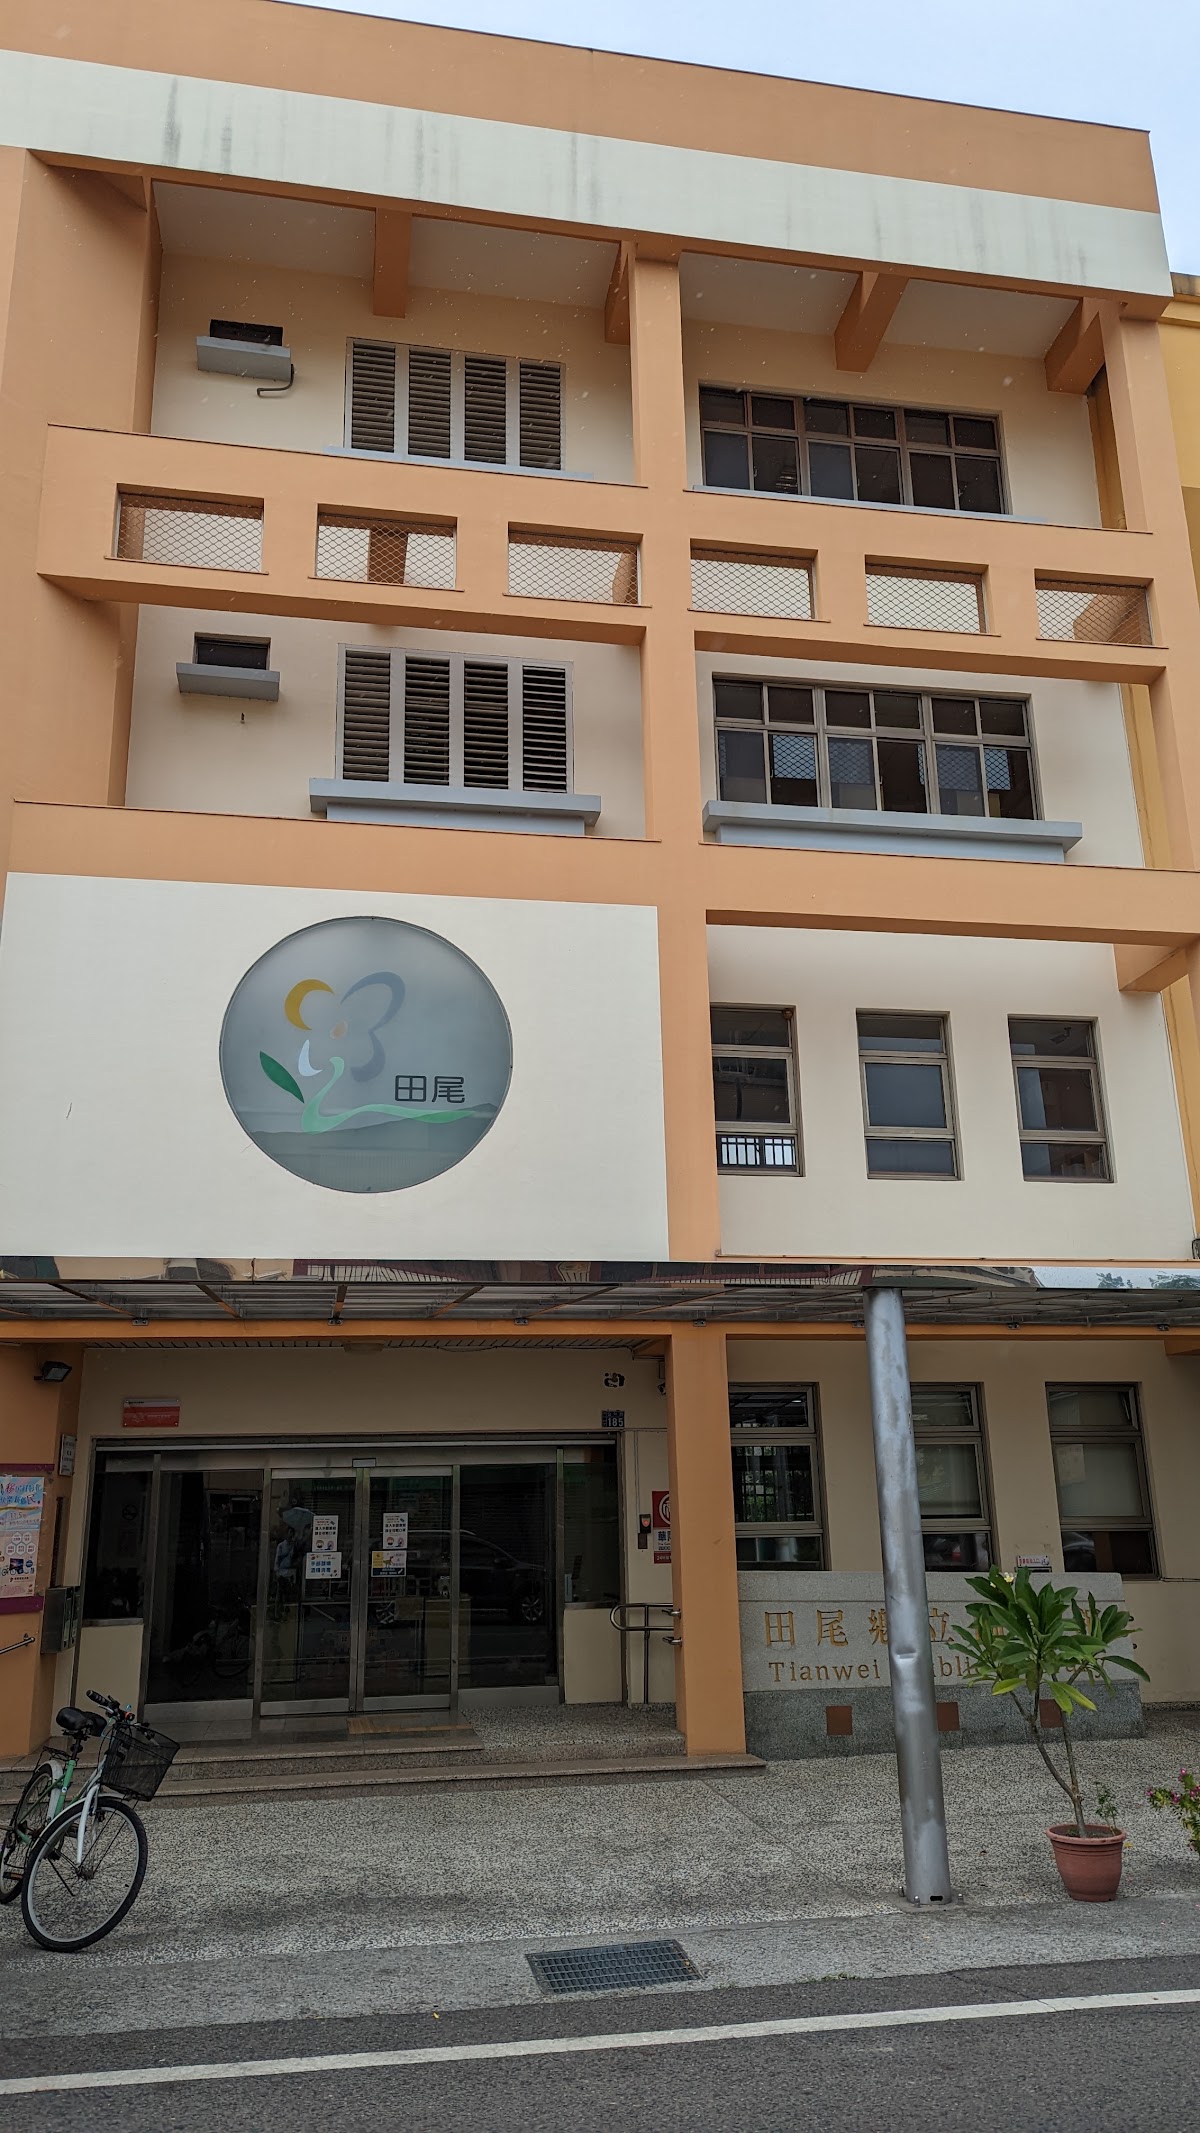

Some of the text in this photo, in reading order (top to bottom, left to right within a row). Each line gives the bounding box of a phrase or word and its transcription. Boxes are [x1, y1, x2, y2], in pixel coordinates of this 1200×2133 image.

[394, 1075, 466, 1103] 田尾
[608, 1417, 624, 1427] 185
[769, 1659, 881, 1682] Tianwei
